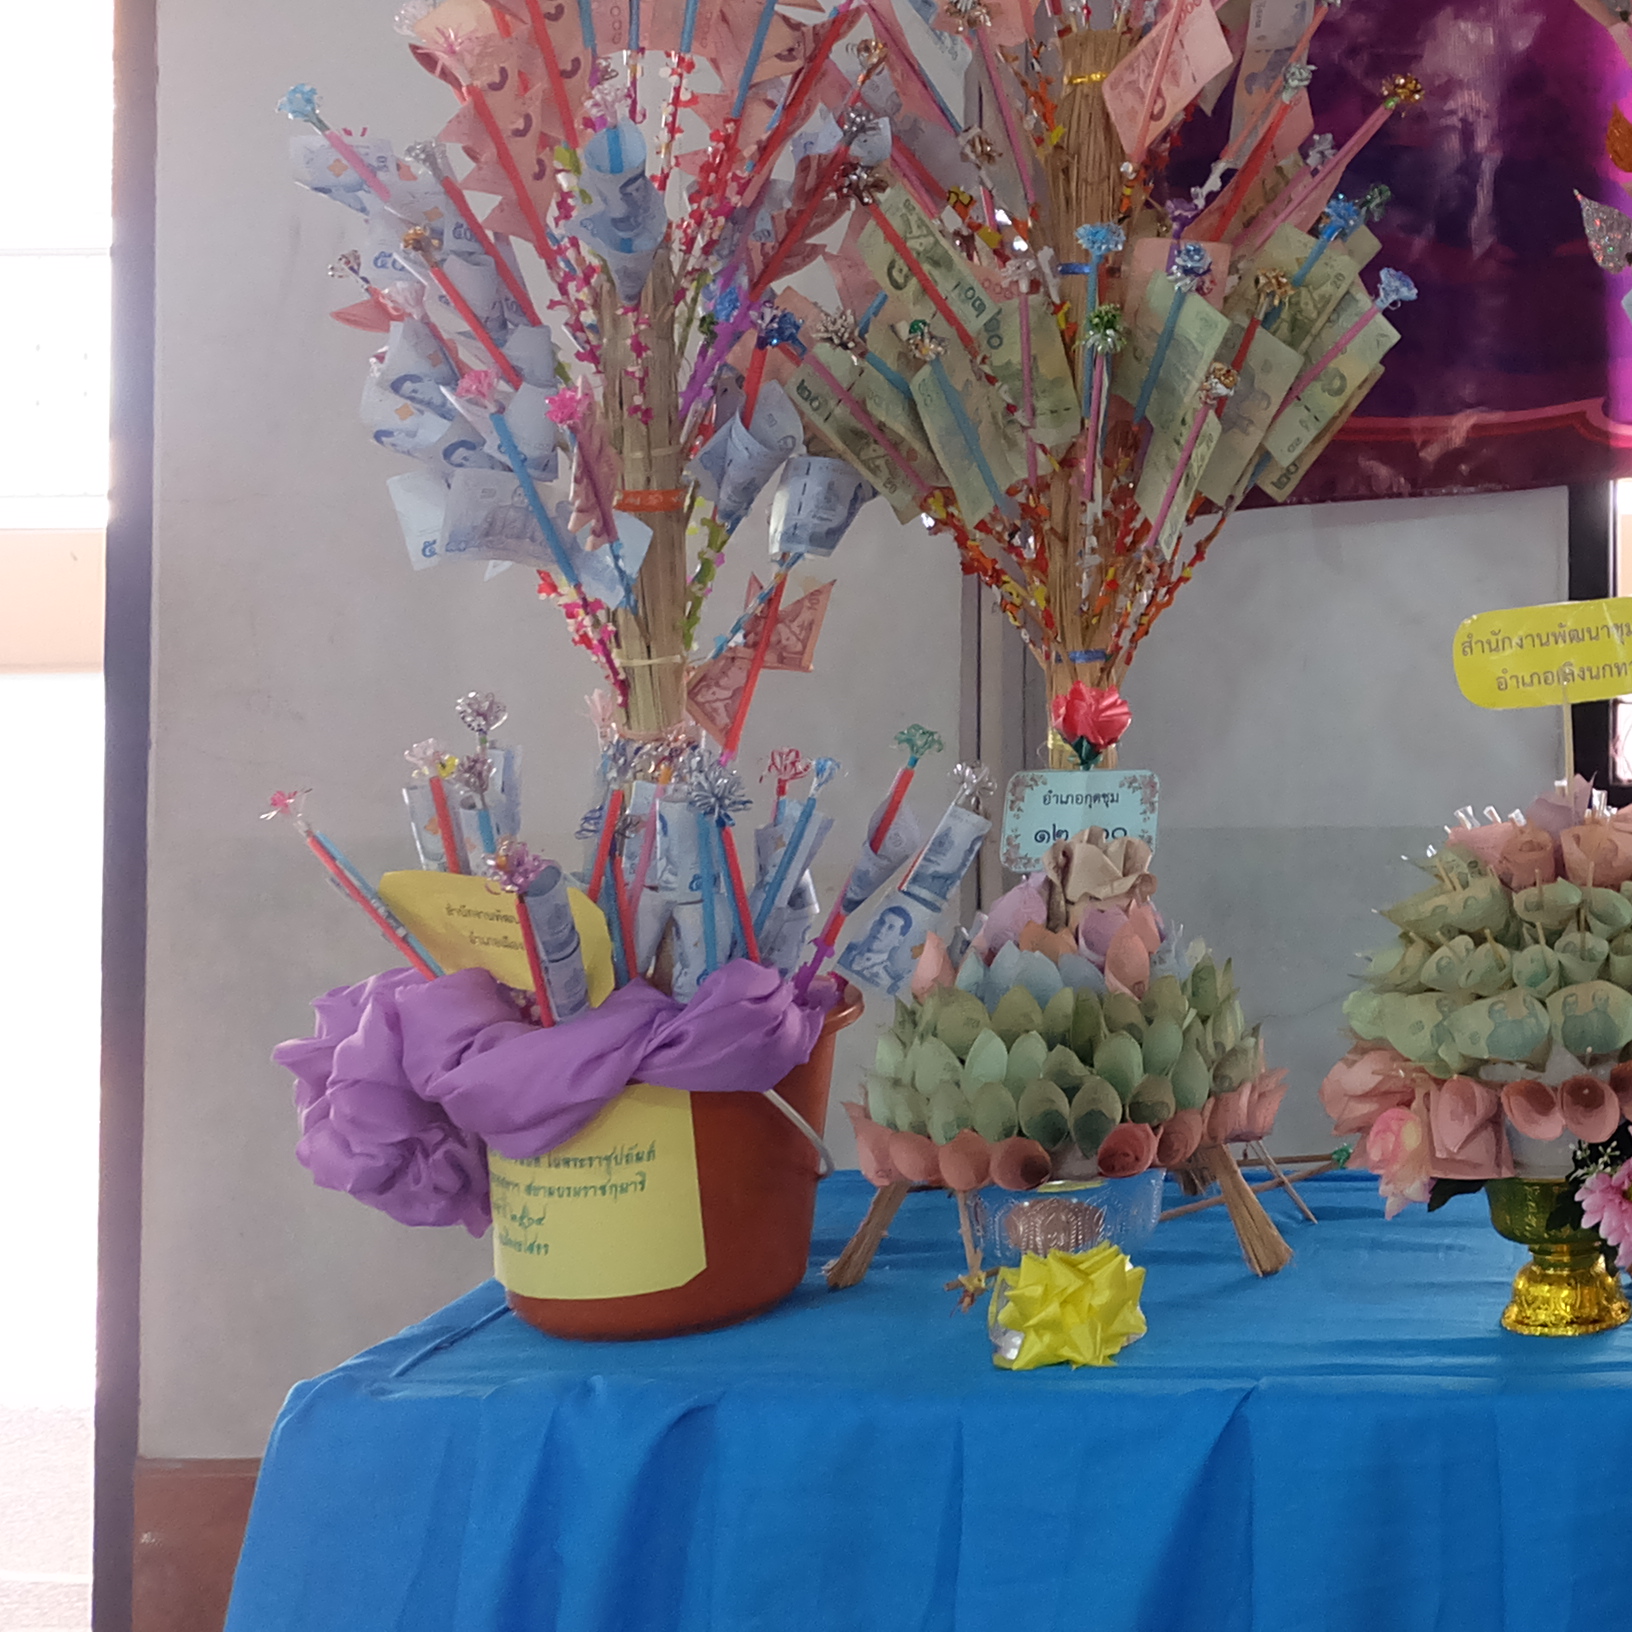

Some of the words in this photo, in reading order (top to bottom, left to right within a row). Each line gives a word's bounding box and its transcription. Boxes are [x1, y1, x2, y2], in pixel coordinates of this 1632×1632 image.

[1042, 789, 1120, 809] อำเภอกุดชุม
